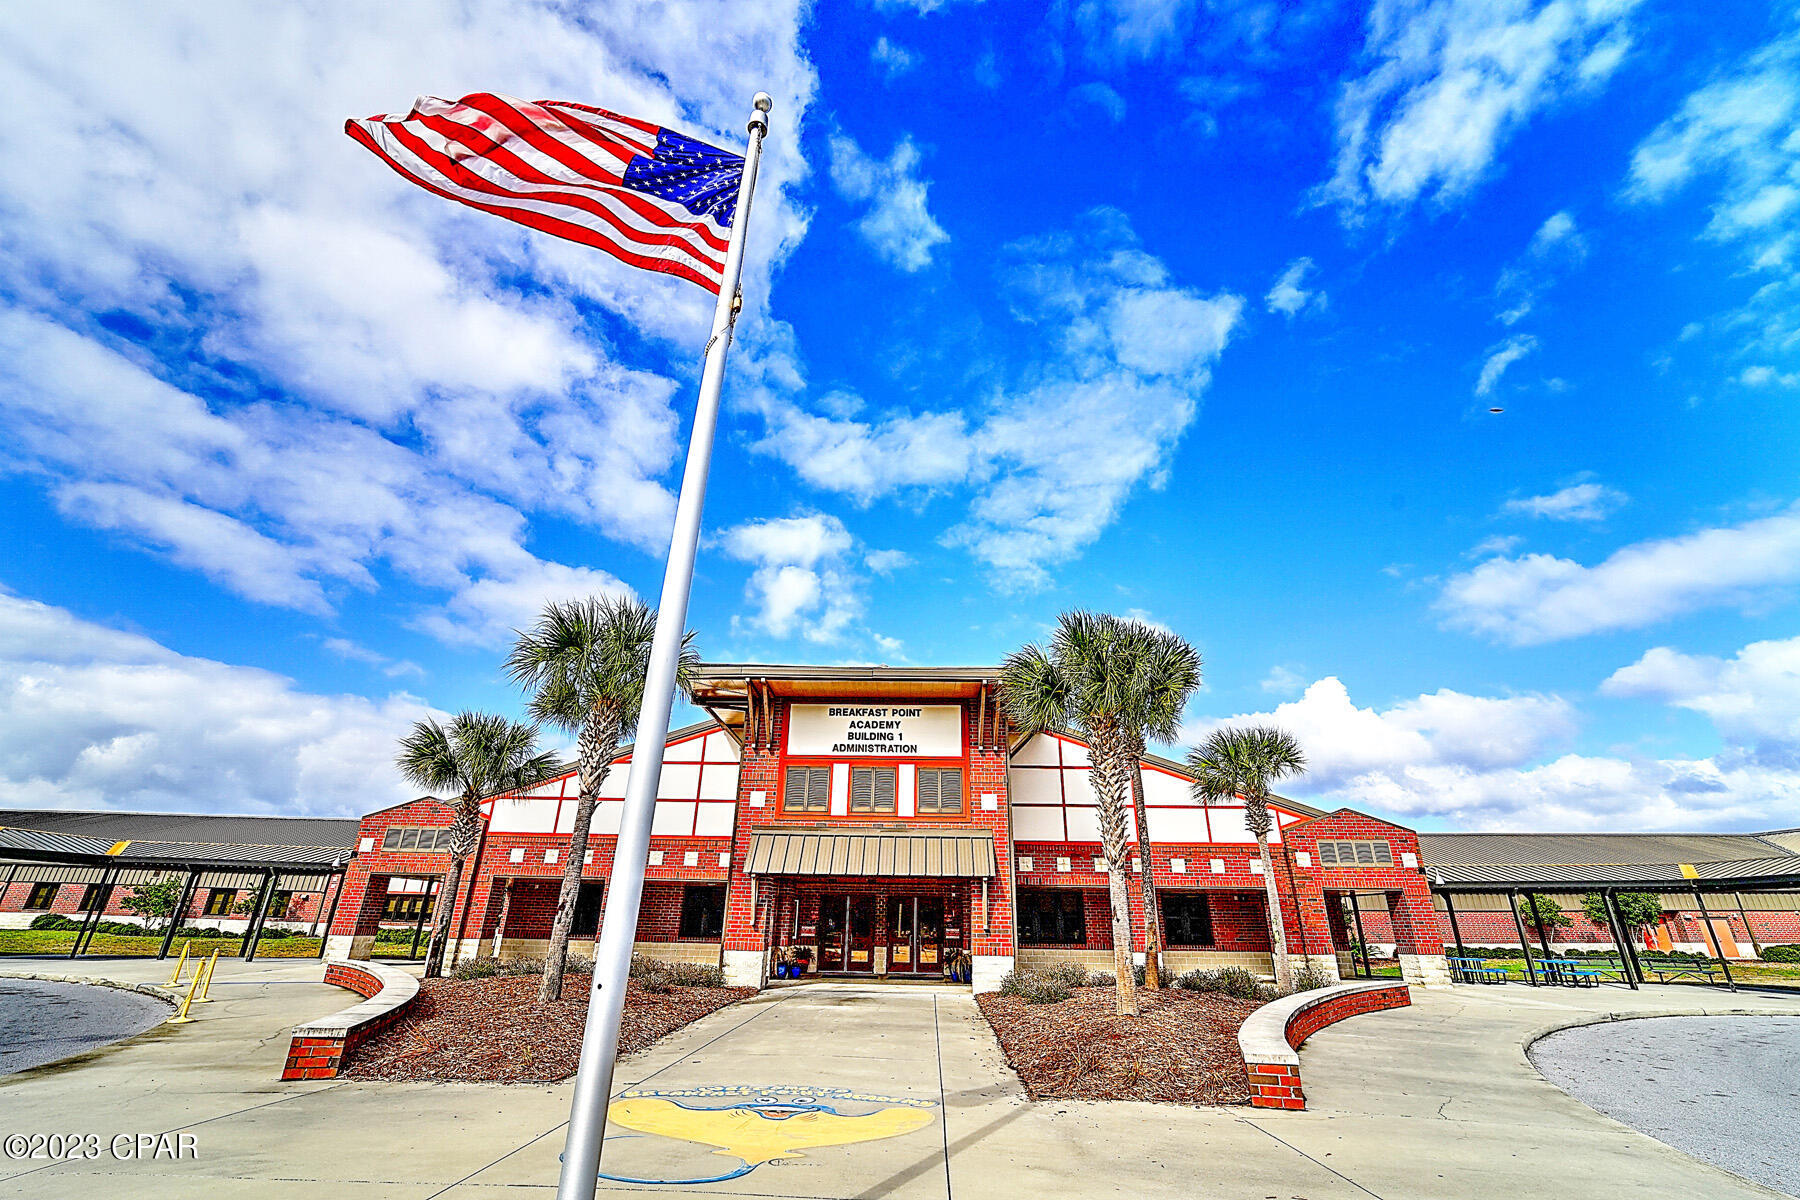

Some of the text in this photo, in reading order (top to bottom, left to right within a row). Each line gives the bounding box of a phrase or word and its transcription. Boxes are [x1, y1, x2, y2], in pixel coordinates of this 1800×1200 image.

[828, 708, 922, 717] BREAKFAST POINT
[849, 720, 901, 729] ACADEMY
[847, 732, 903, 741] BUILDING 1
[832, 744, 917, 753] ADMINISTRATION
